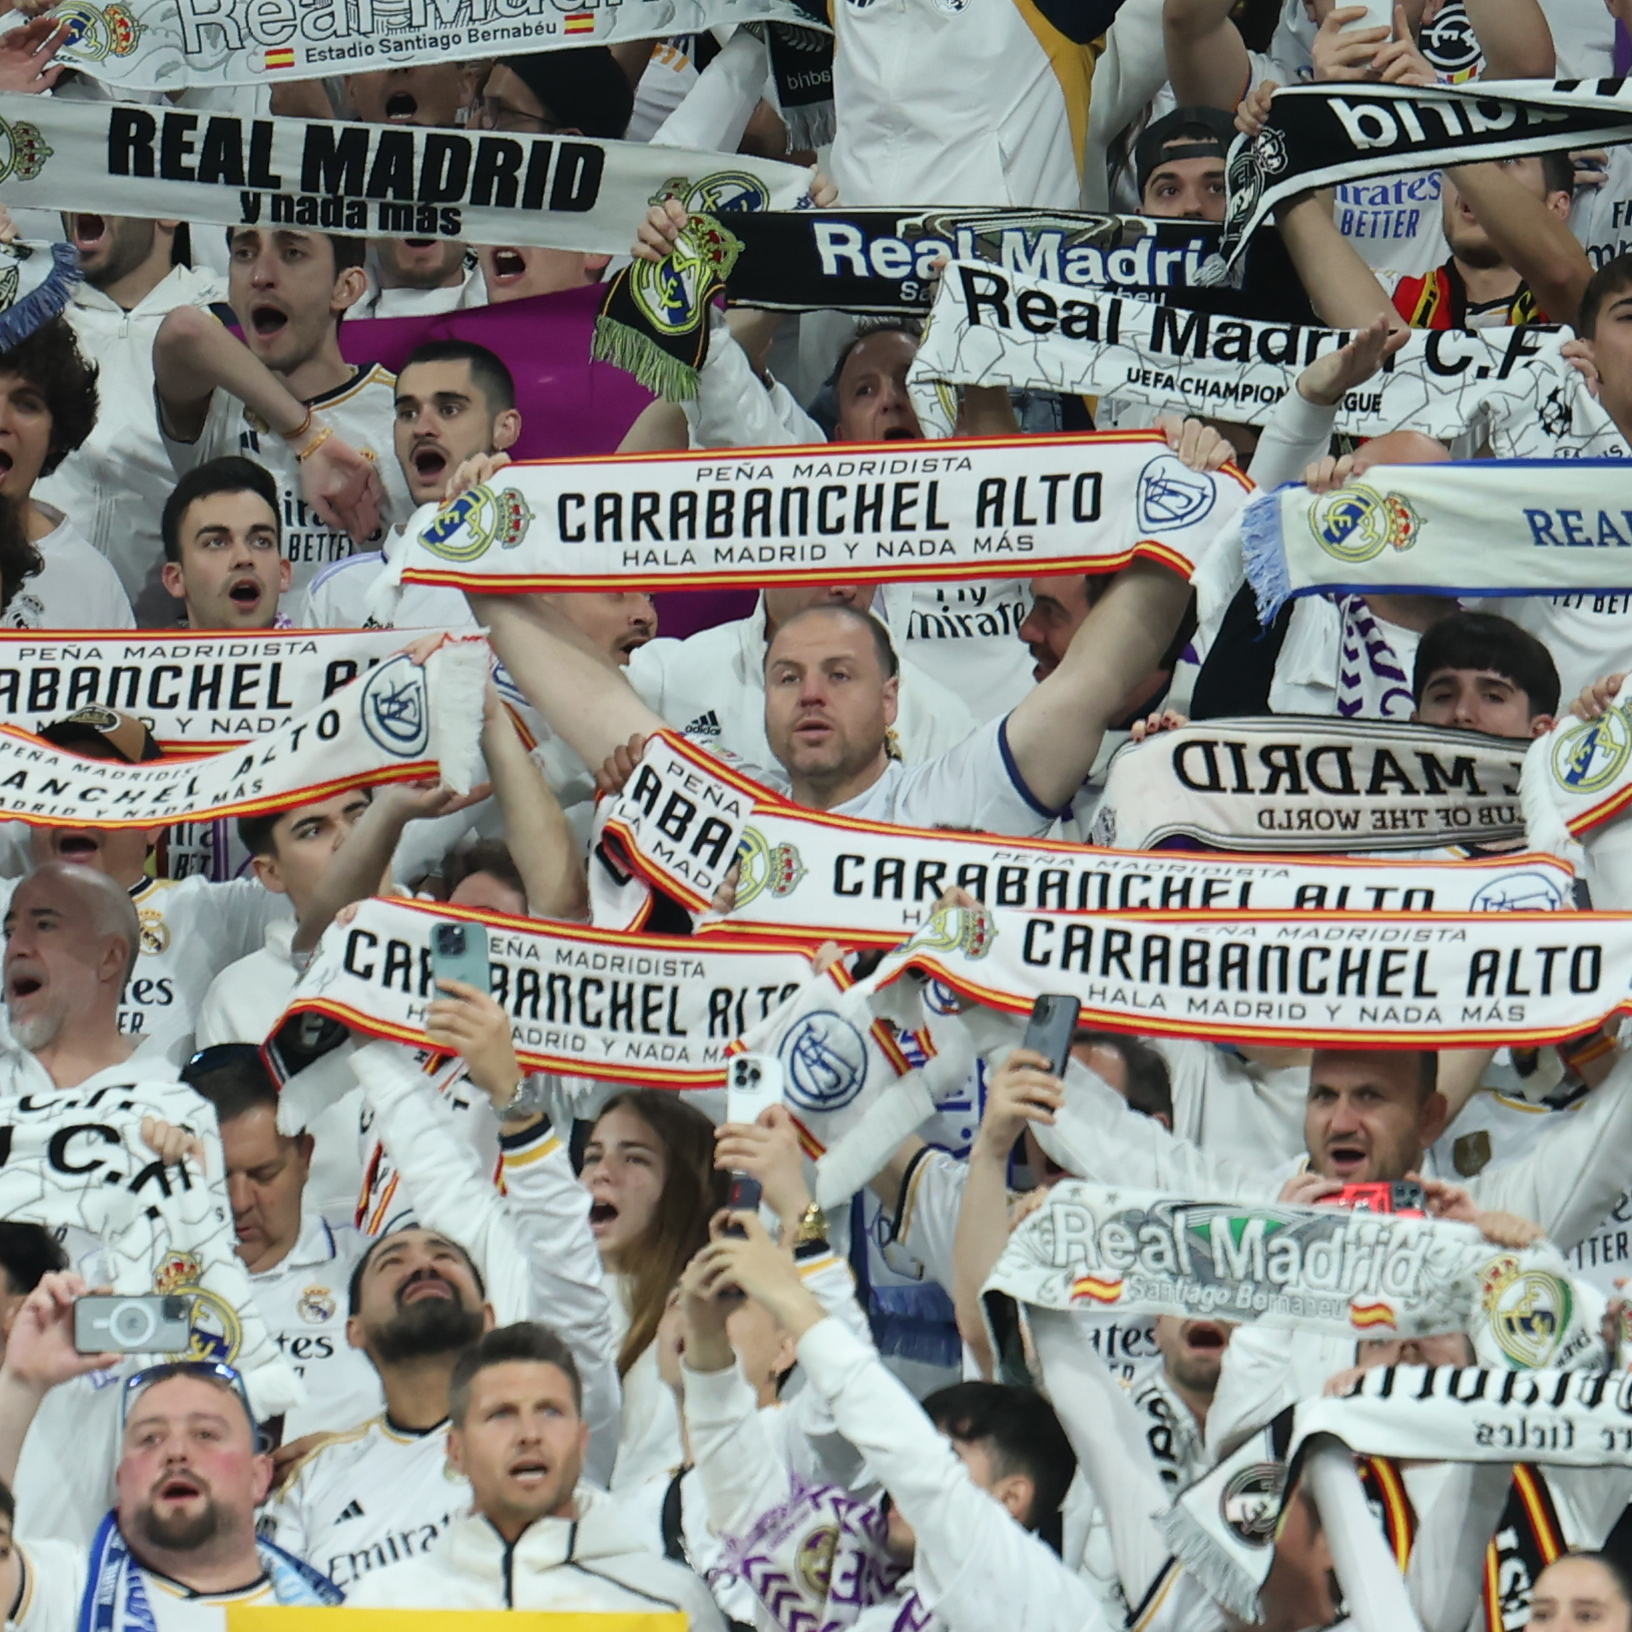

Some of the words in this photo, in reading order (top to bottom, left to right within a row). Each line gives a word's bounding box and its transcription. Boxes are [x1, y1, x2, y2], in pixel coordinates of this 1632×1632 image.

[304, 41, 376, 65] Estadio
[378, 33, 462, 61] Santiago
[467, 17, 558, 47] Bernabéu
[107, 105, 281, 191] REAL
[300, 121, 606, 214] MADRID
[266, 189, 368, 230] nada
[377, 200, 462, 236] más
[1340, 207, 1422, 240] BETTER
[814, 221, 977, 281] Real
[958, 262, 1120, 346] Real
[1126, 367, 1177, 392] UEFA
[696, 457, 755, 483] PEÑA
[765, 455, 974, 481] MADRIDISTA
[557, 480, 951, 544] CARABANCHEL
[977, 472, 1103, 526] ALTO
[623, 546, 706, 567] HALA
[714, 540, 826, 566] MADRID
[865, 536, 960, 558] NADA
[970, 529, 1036, 555] MÁS
[18, 641, 106, 663] PEÑA
[122, 638, 319, 661] MADRIDISTA
[664, 761, 741, 817] PEÑA
[832, 851, 1257, 910] CARABANCHEL
[1086, 856, 1291, 880] MADRIDISTA
[553, 944, 706, 978] MADRIDISTA
[1023, 914, 1438, 1000] CARABANCHEL
[1467, 944, 1602, 1000] ALTO
[1088, 981, 1167, 1011] HALA
[1187, 998, 1309, 1024] MADRID
[1353, 1002, 1440, 1026] NADA
[1460, 997, 1527, 1023] MÁS
[625, 1040, 691, 1062] NADA
[1052, 1201, 1190, 1274] Real
[1208, 1213, 1440, 1294] Madrid
